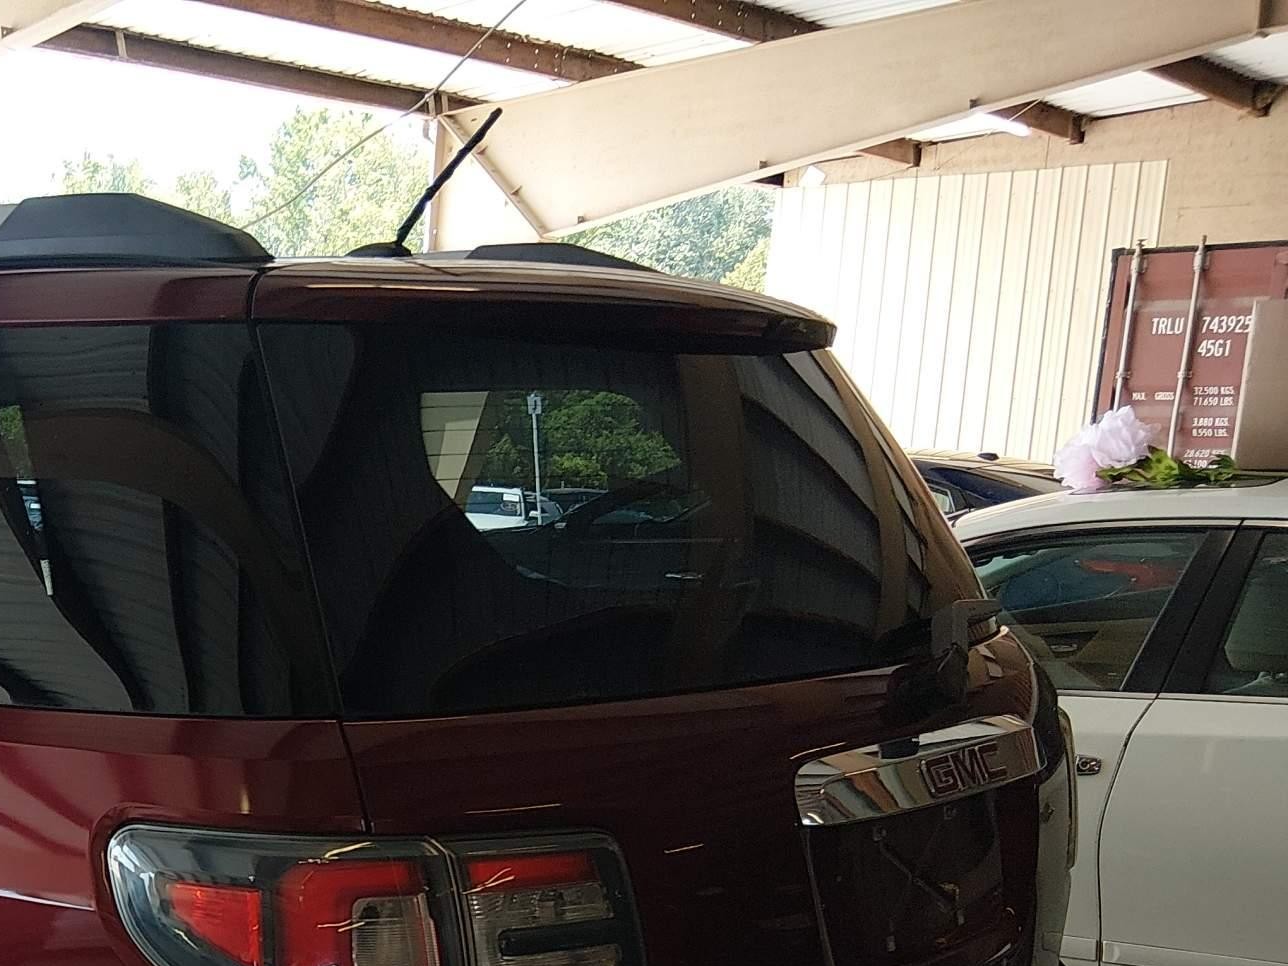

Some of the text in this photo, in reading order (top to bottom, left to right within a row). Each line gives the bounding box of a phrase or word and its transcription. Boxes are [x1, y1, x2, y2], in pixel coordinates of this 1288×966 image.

[1151, 314, 1253, 335] TRLU 743925
[1197, 339, 1231, 357] 45G1
[923, 740, 1008, 797] GMC
